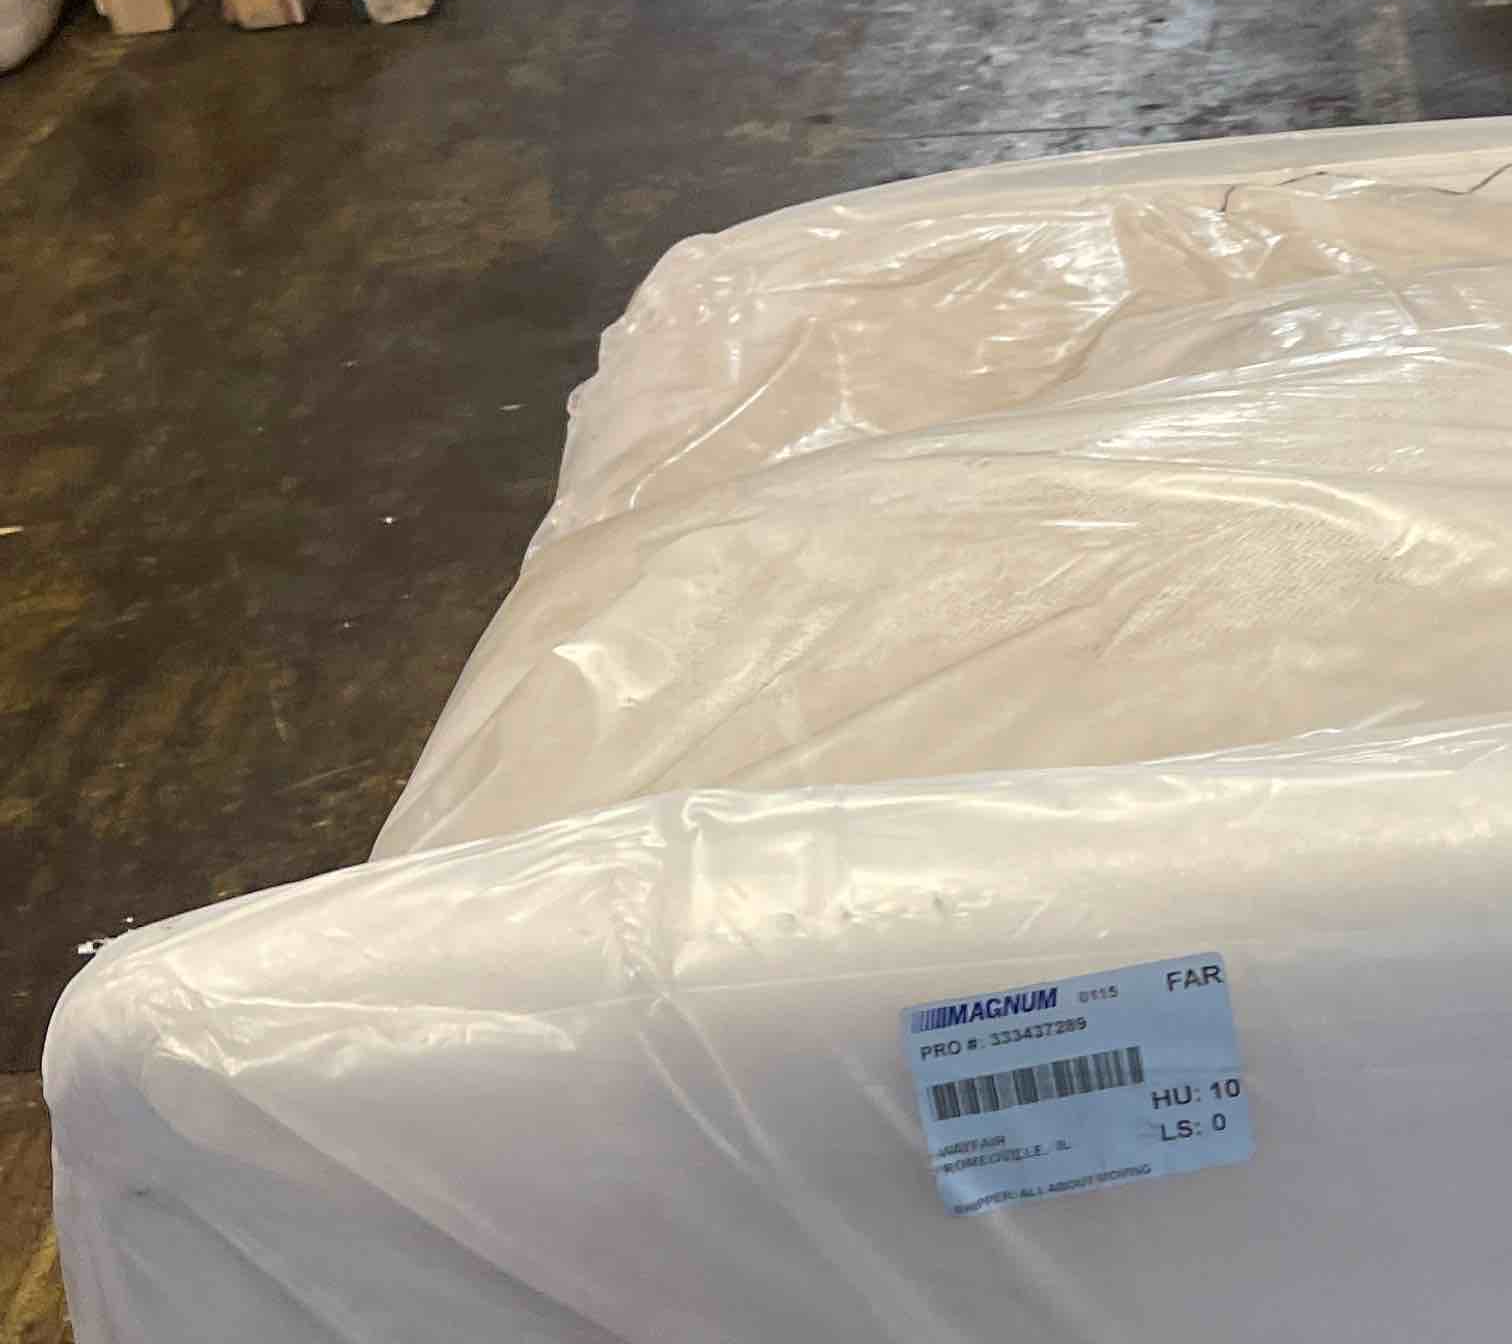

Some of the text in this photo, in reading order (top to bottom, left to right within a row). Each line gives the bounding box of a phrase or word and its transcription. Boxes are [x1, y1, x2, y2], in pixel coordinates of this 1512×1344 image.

[946, 987, 1058, 1025] MAGNUM
[1166, 965, 1224, 992] FAR
[920, 1039, 962, 1060] PRO
[1151, 1078, 1241, 1110] HU: 10
[1160, 1113, 1227, 1142] LS: 0
